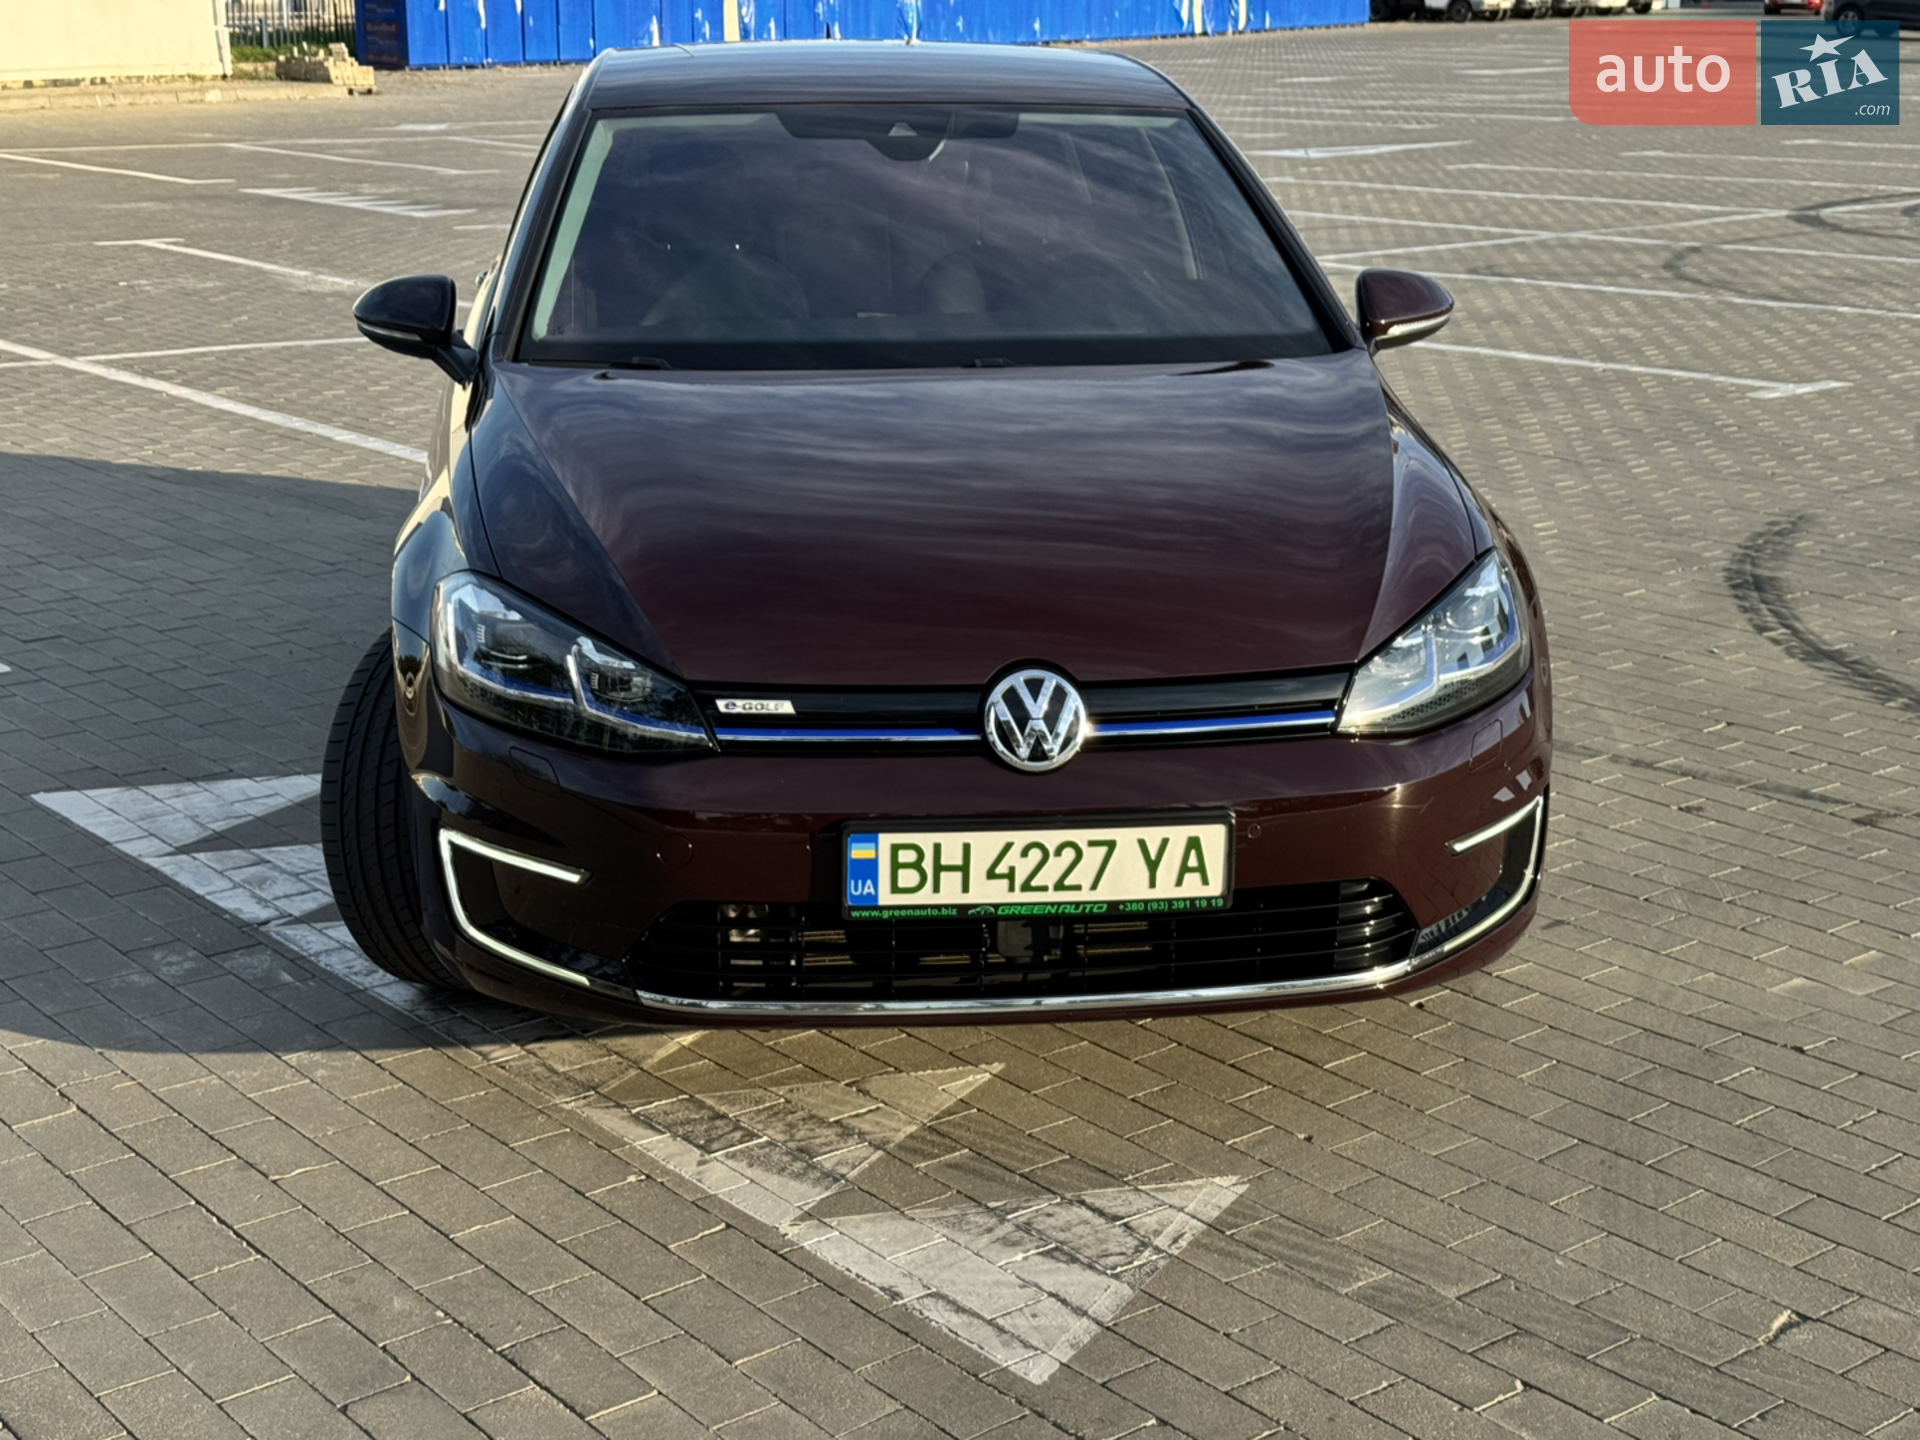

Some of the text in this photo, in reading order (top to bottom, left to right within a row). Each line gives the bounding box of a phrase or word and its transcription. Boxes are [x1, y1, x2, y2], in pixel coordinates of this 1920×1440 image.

[889, 835, 1211, 895] BH 4227 YA
[850, 879, 876, 896] UA
[997, 903, 1108, 916] GREENAUTO
[1118, 897, 1224, 912] +380 (93) 391 19 19
[850, 907, 958, 918] www.greenauto.biz
